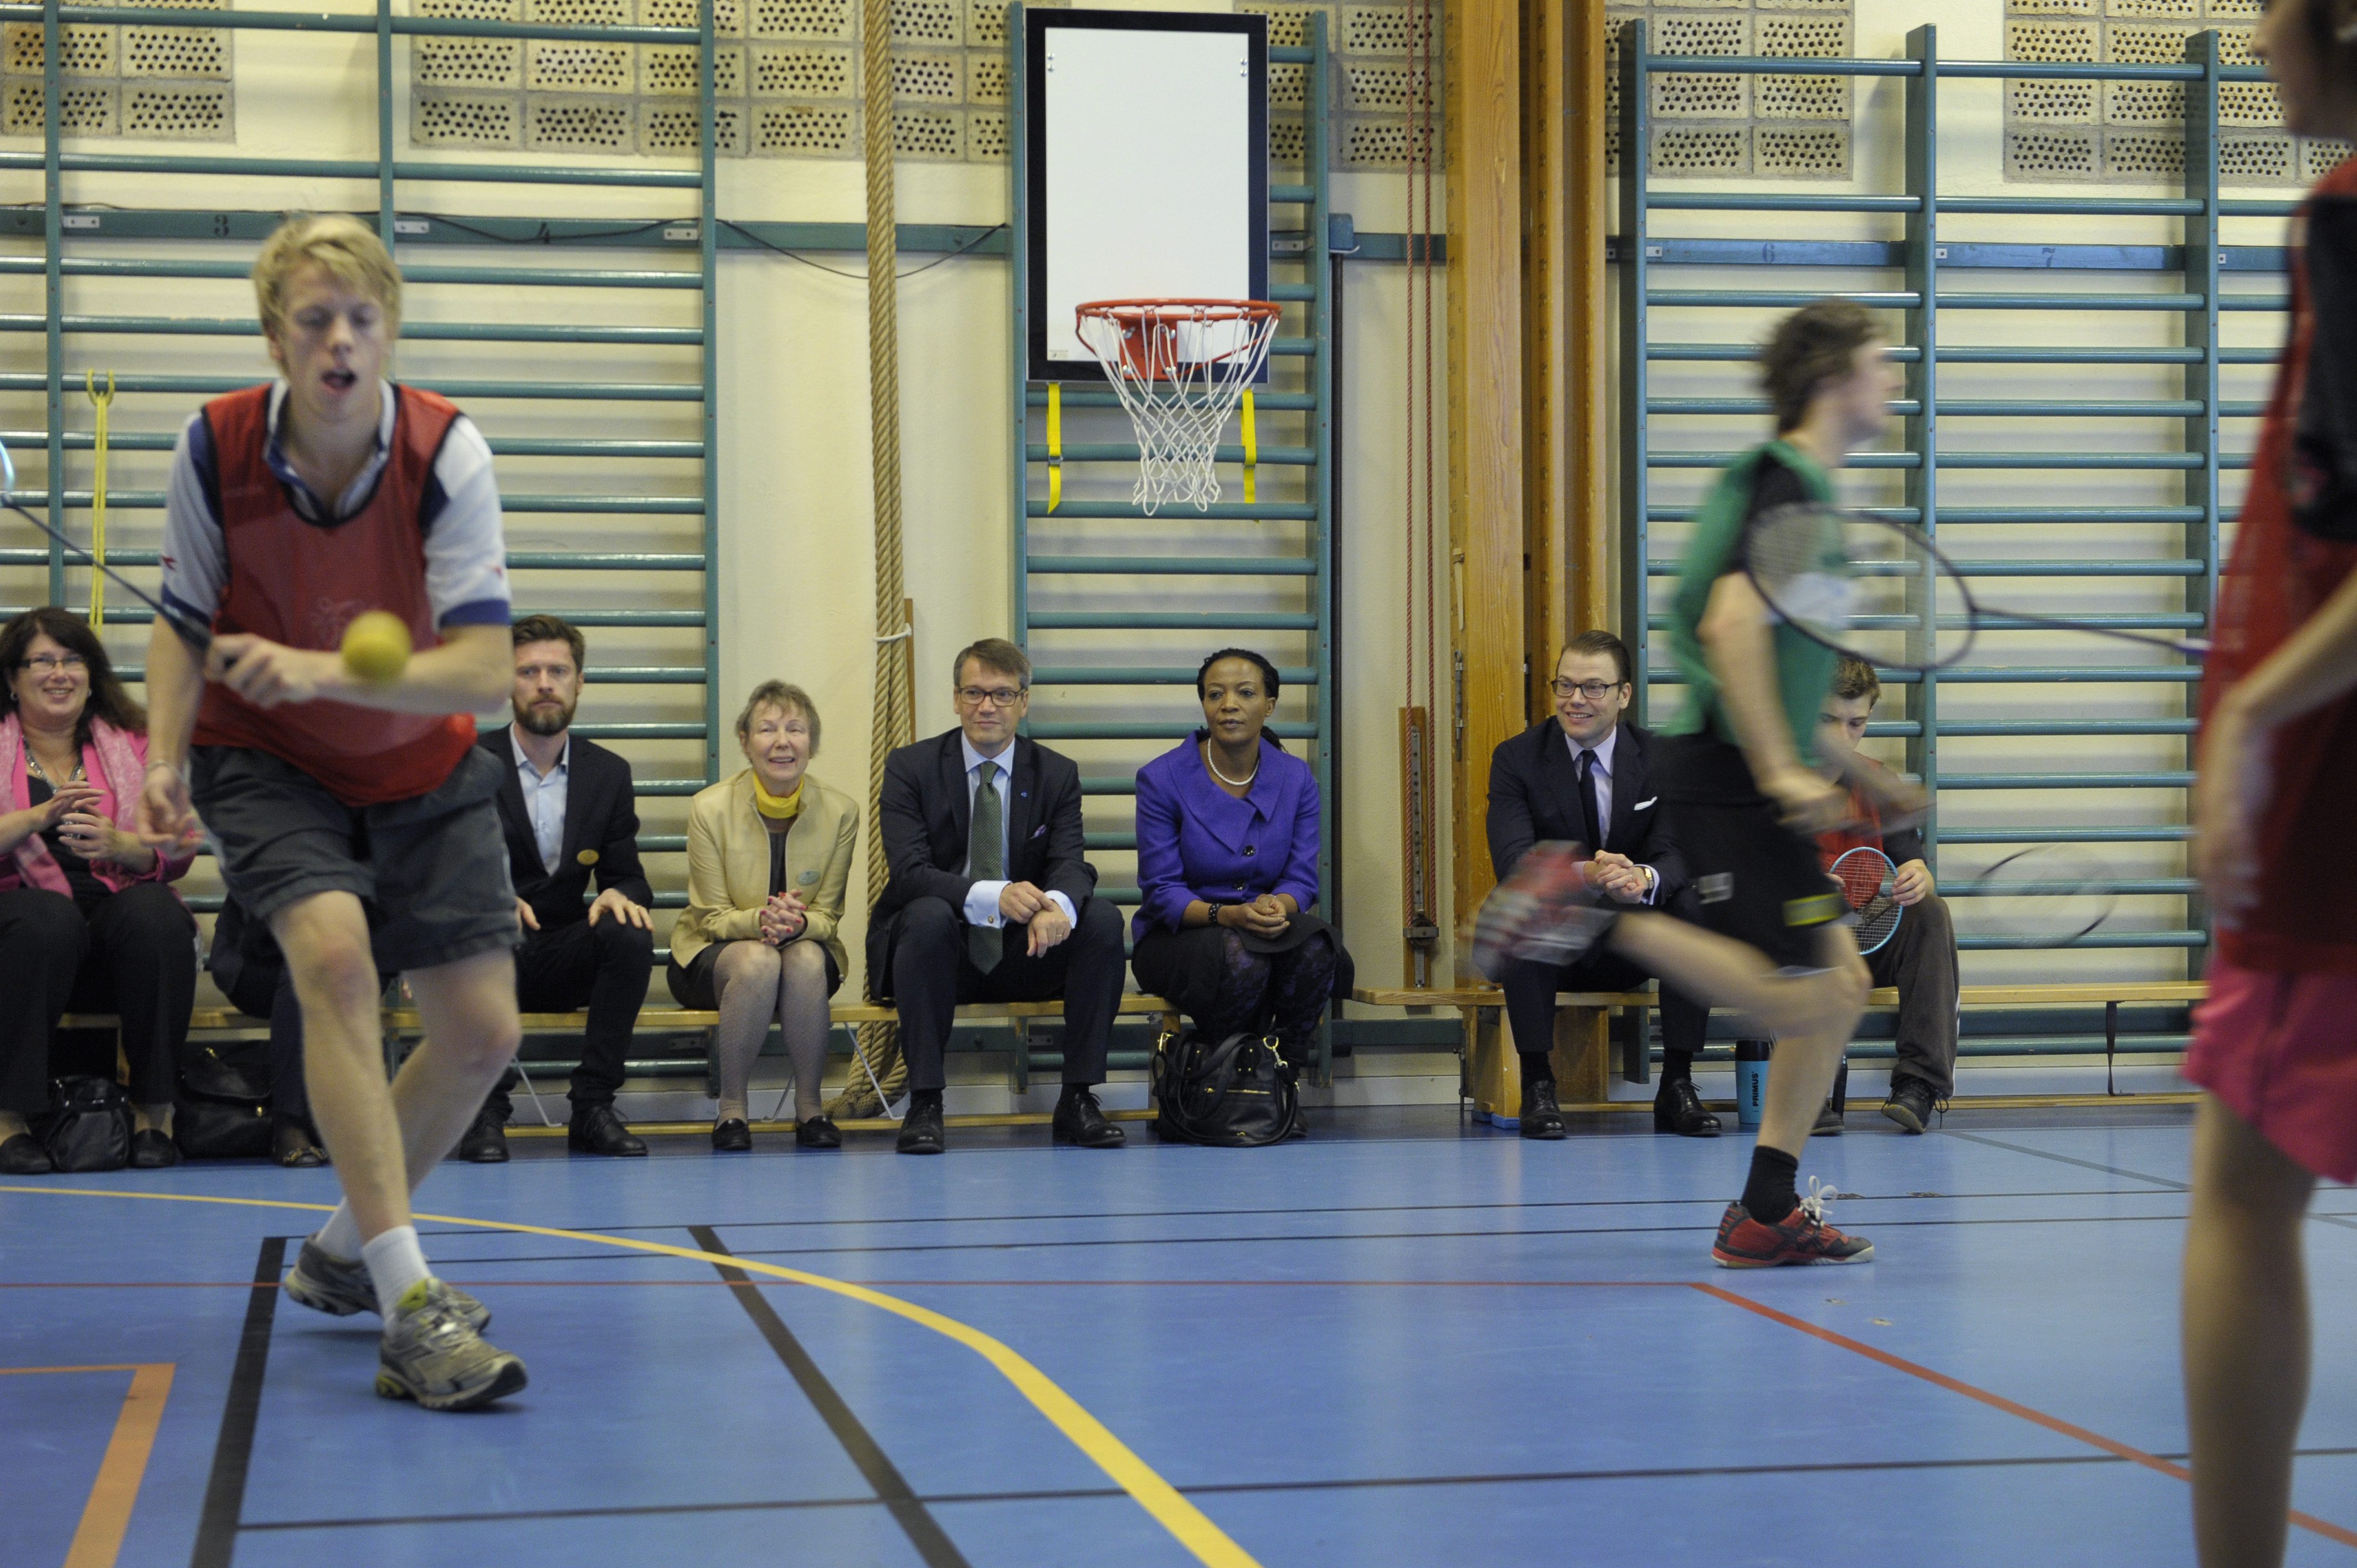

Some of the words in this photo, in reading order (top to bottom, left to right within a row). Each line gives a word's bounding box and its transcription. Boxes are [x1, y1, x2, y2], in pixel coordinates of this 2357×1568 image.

[214, 214, 229, 237] 3
[537, 221, 550, 245] 4
[1762, 242, 1775, 264] 6
[2042, 247, 2055, 267] 7
